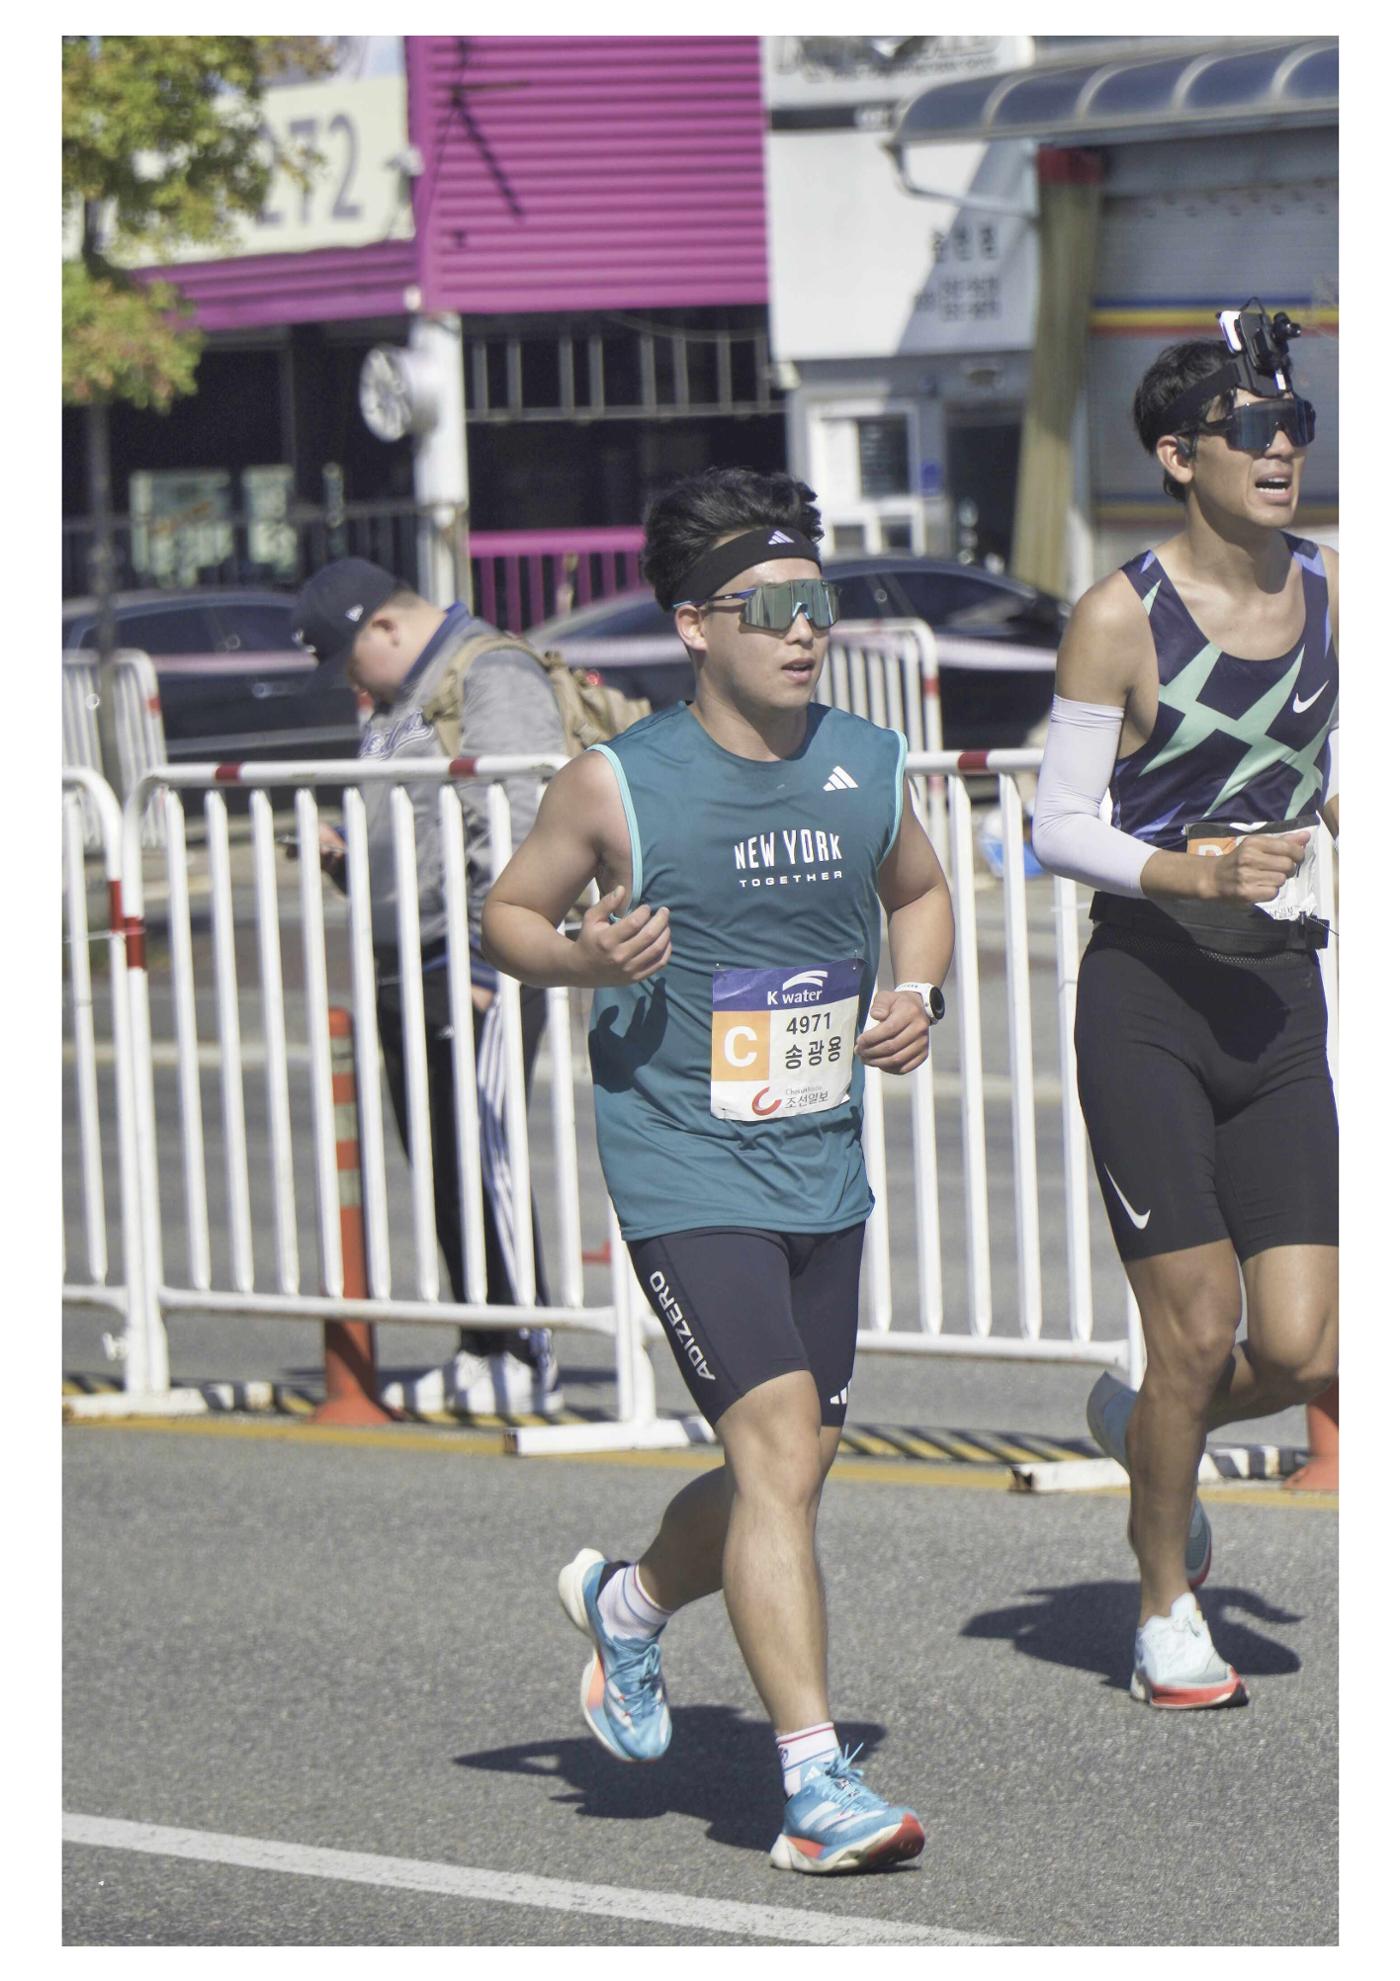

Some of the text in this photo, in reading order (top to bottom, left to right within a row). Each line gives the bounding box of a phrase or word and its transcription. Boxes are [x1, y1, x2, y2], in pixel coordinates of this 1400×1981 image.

[734, 829, 842, 869] NEW YORK
[739, 871, 842, 887] TOGETHER
[767, 989, 822, 1005] K water
[786, 1012, 831, 1034] 4971
[724, 1026, 758, 1067] C
[785, 1036, 841, 1070] 송광용
[784, 1090, 829, 1108] 조선일보
[649, 1270, 716, 1381] ADIZERO
